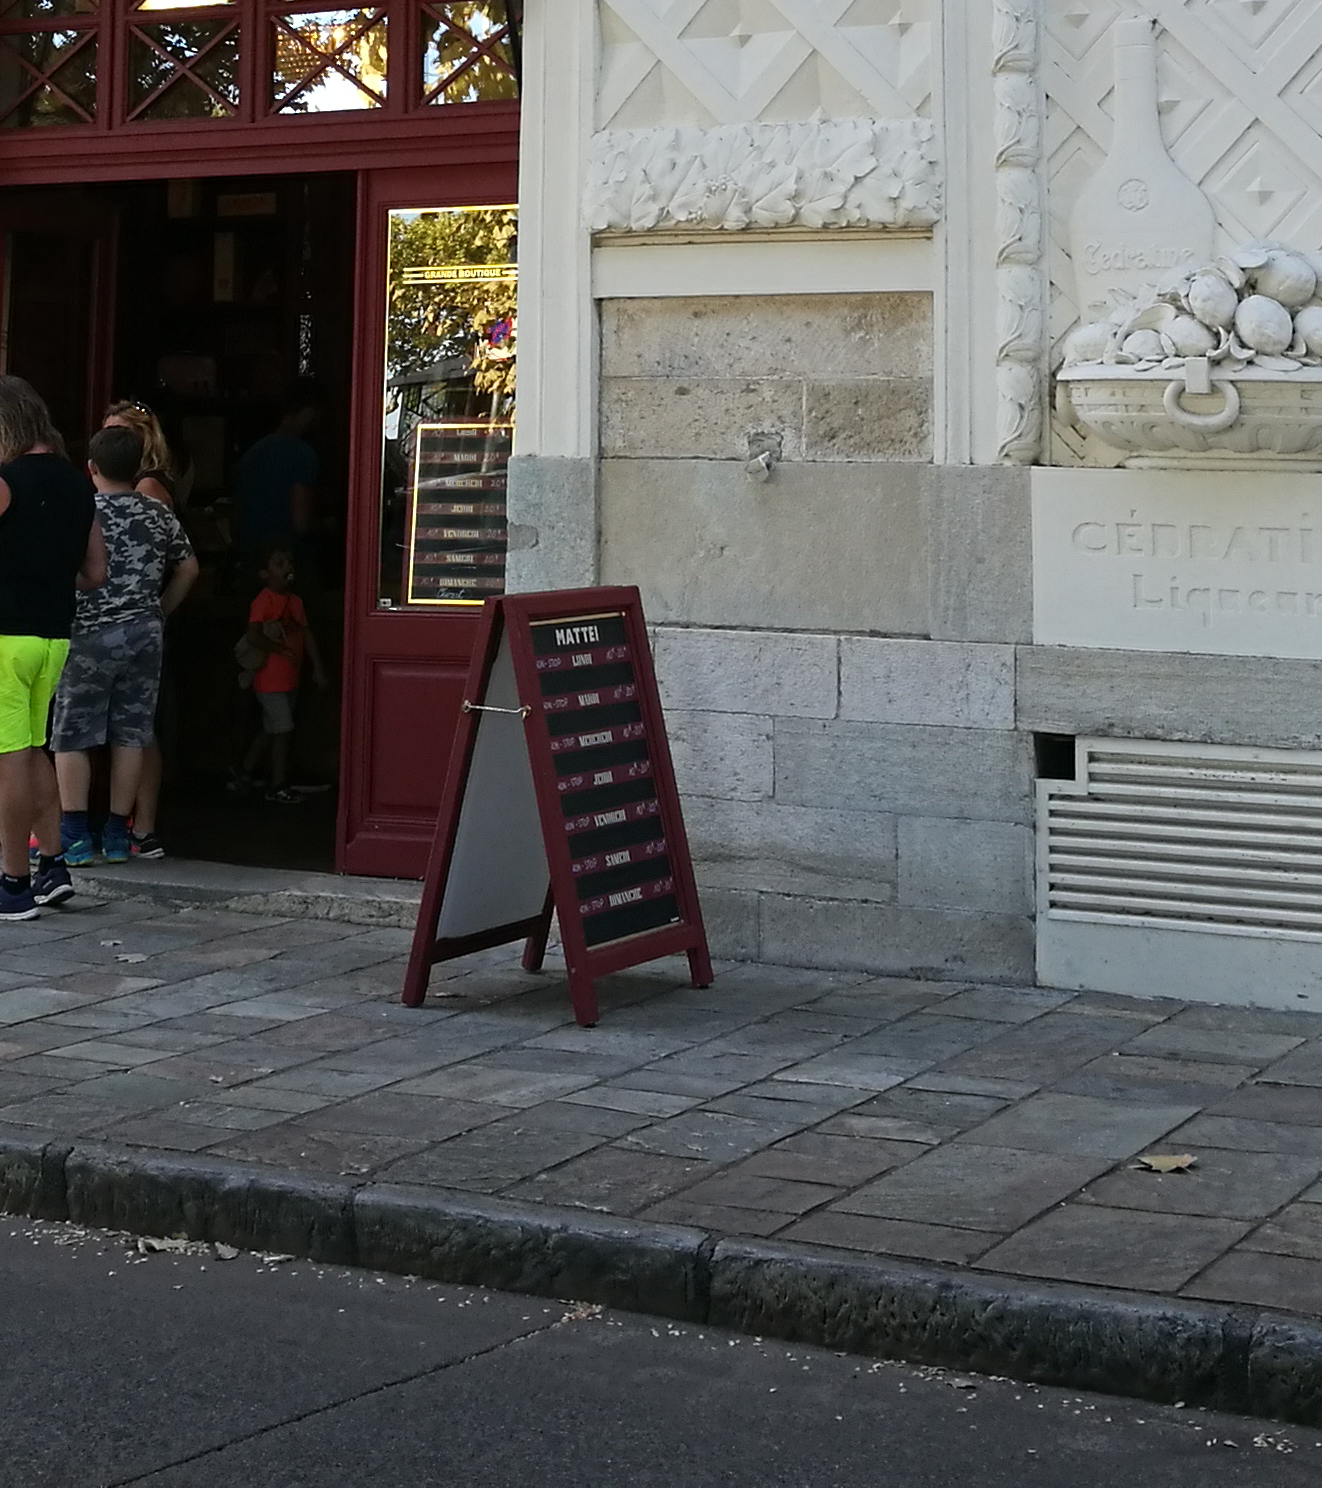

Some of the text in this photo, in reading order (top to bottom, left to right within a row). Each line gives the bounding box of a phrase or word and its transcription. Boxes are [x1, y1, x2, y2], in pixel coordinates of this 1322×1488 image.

[424, 269, 501, 279] GRANDE BOUTIQUE
[555, 625, 599, 646] MATTEI
